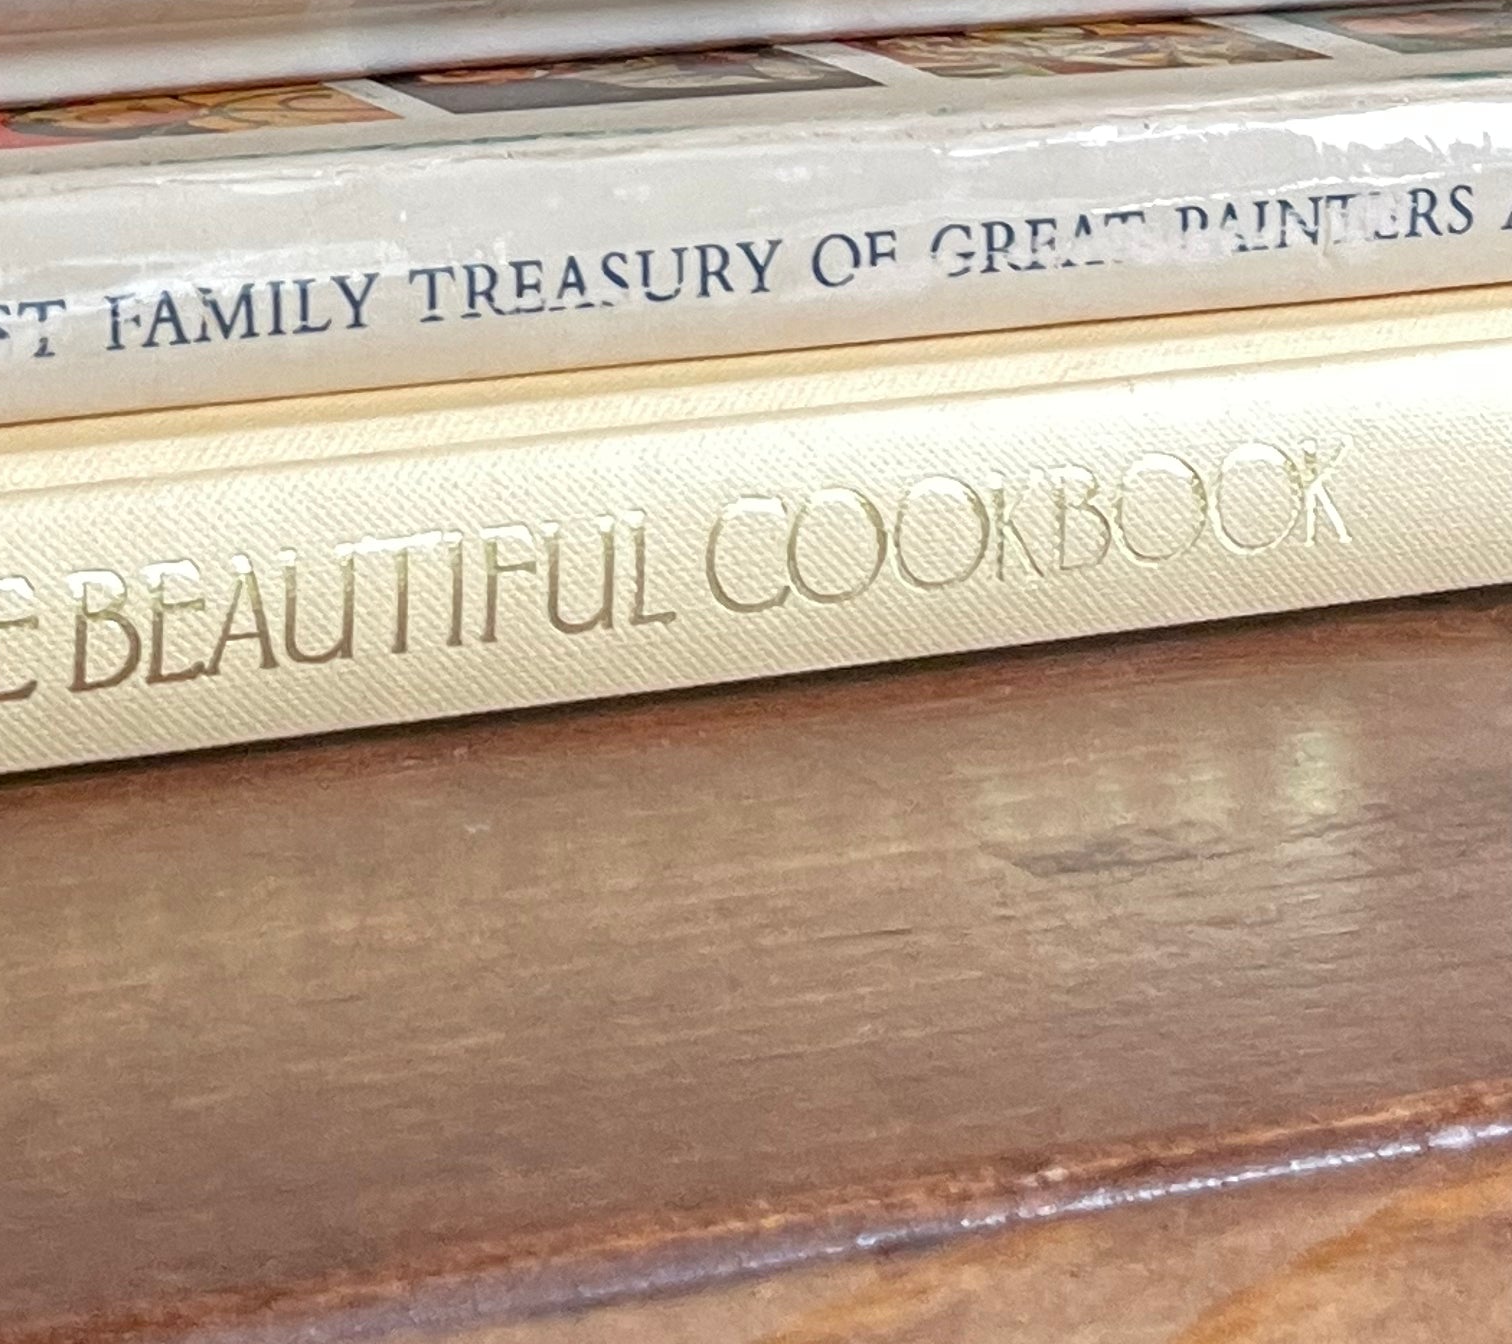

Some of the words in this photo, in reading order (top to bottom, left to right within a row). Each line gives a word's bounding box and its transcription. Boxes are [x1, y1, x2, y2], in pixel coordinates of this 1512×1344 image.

[103, 272, 381, 351] FAMILY
[408, 239, 783, 323] TREASURY
[811, 230, 898, 287] OF
[1175, 183, 1475, 252] PAINTRS
[67, 507, 677, 693] BEAUTIFUL
[704, 434, 1354, 613] COOKBOOK
